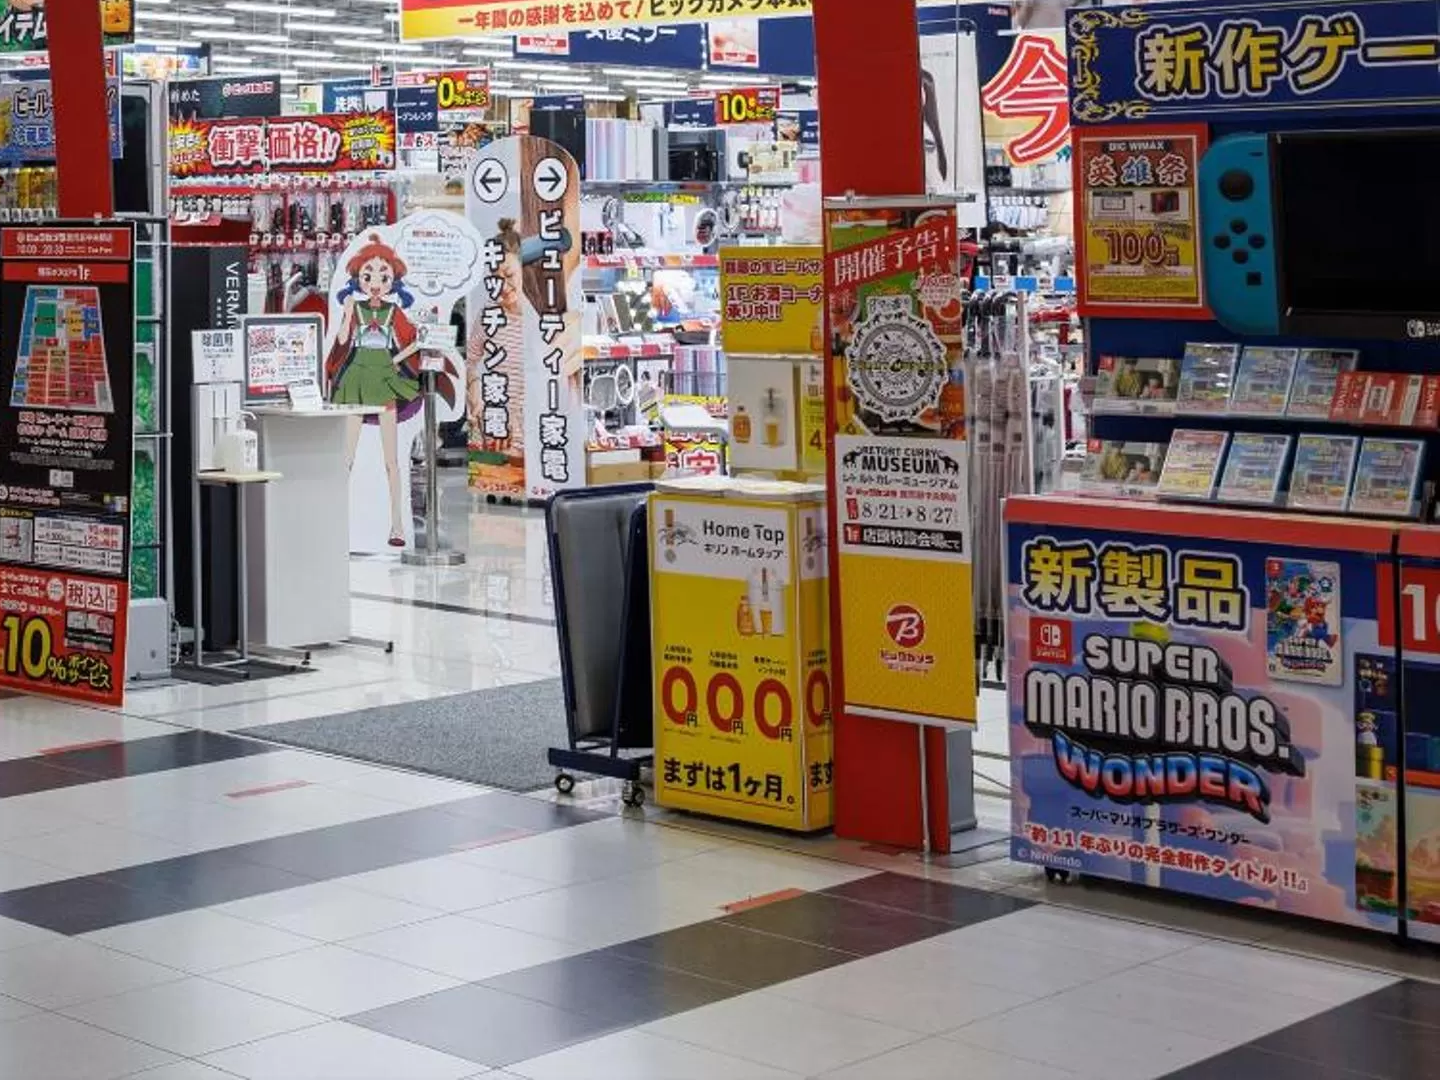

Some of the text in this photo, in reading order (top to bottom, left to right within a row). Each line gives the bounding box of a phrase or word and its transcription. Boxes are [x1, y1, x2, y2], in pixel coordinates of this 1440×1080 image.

[1138, 13, 1439, 97] 新作ゲー
[209, 123, 341, 166] 衝撃価格!!
[834, 225, 950, 286] 開催予告!
[482, 240, 509, 439] キッチン家電
[538, 210, 569, 482] ビューティー家電
[861, 456, 940, 474] MUSEUM
[703, 520, 784, 545] Home Tap
[1024, 538, 1246, 630] 新製品
[1086, 635, 1220, 683] SUPER
[1027, 671, 1290, 758] MARIO BROS.
[1054, 732, 1266, 815] WONDER
